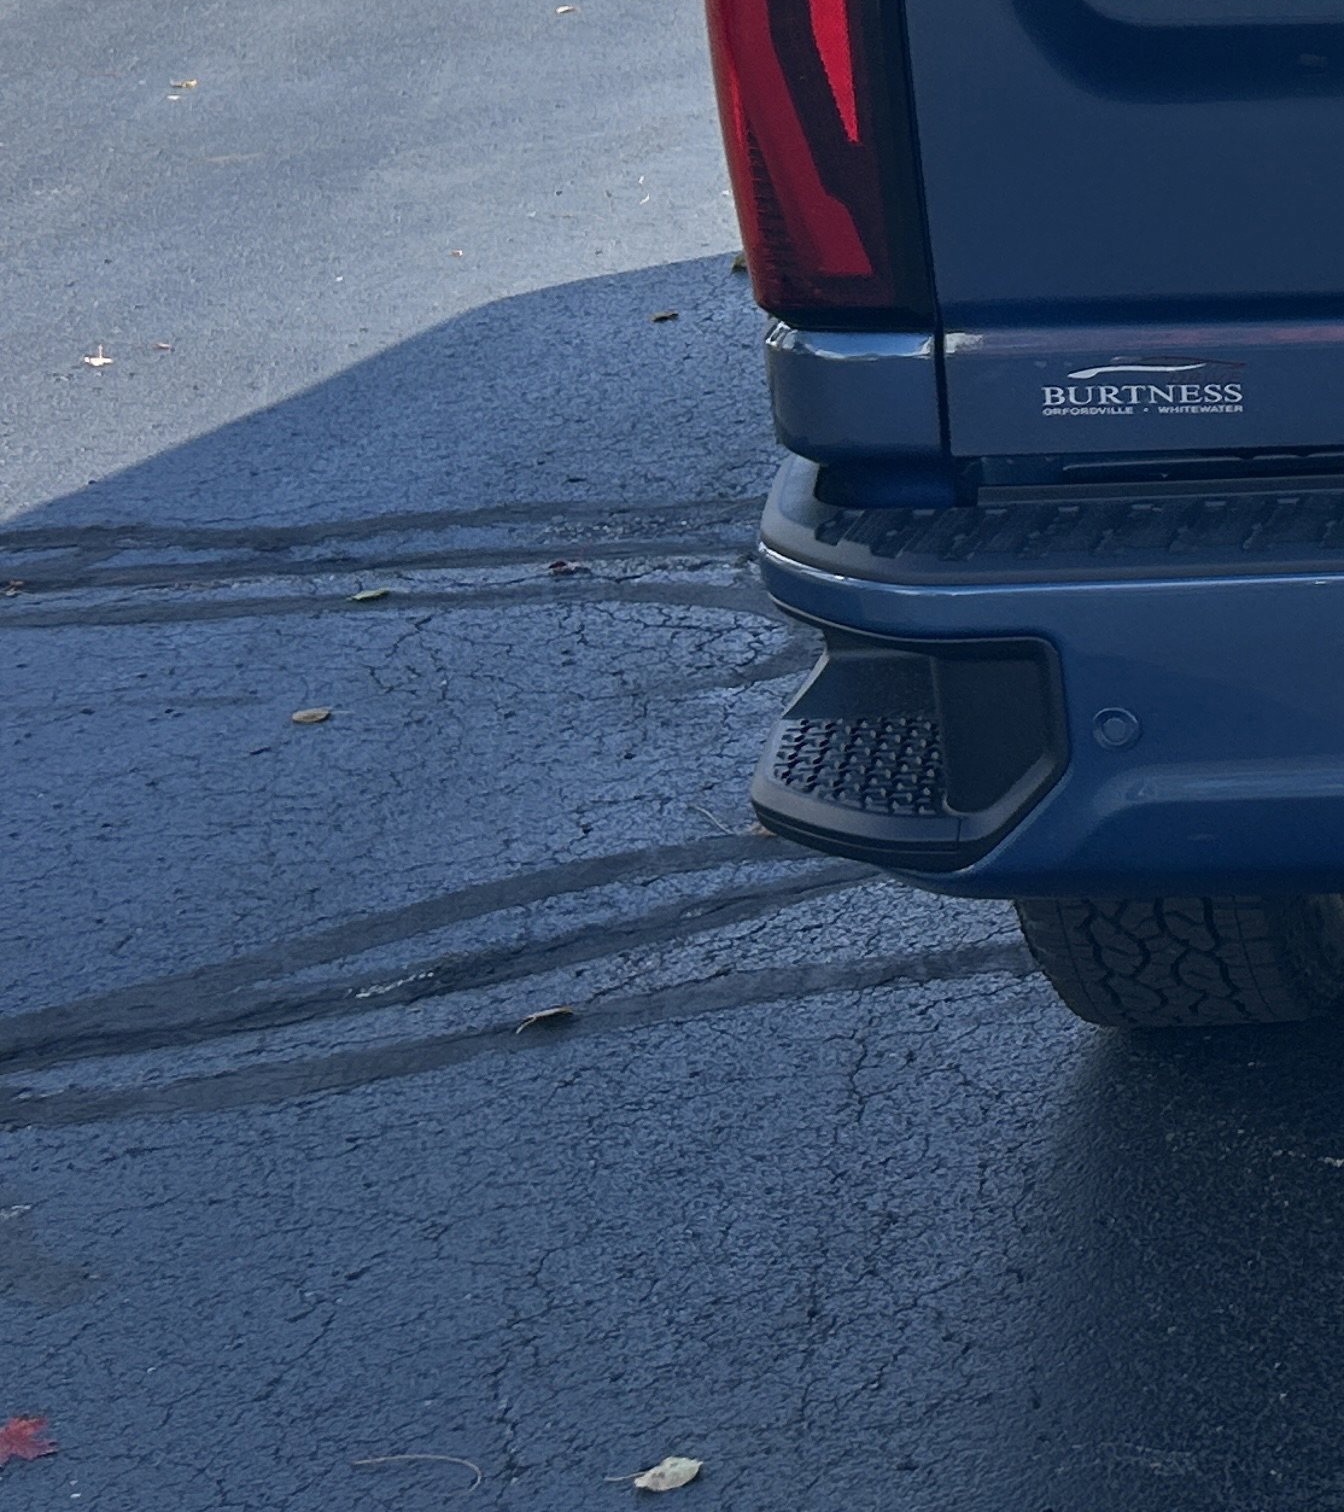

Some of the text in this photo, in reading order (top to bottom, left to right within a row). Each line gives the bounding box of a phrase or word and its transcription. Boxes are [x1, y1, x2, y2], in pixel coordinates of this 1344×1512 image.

[1041, 384, 1243, 405] BURTNESS
[1042, 405, 1244, 417] ORFORDVILLE WHITEWATER
